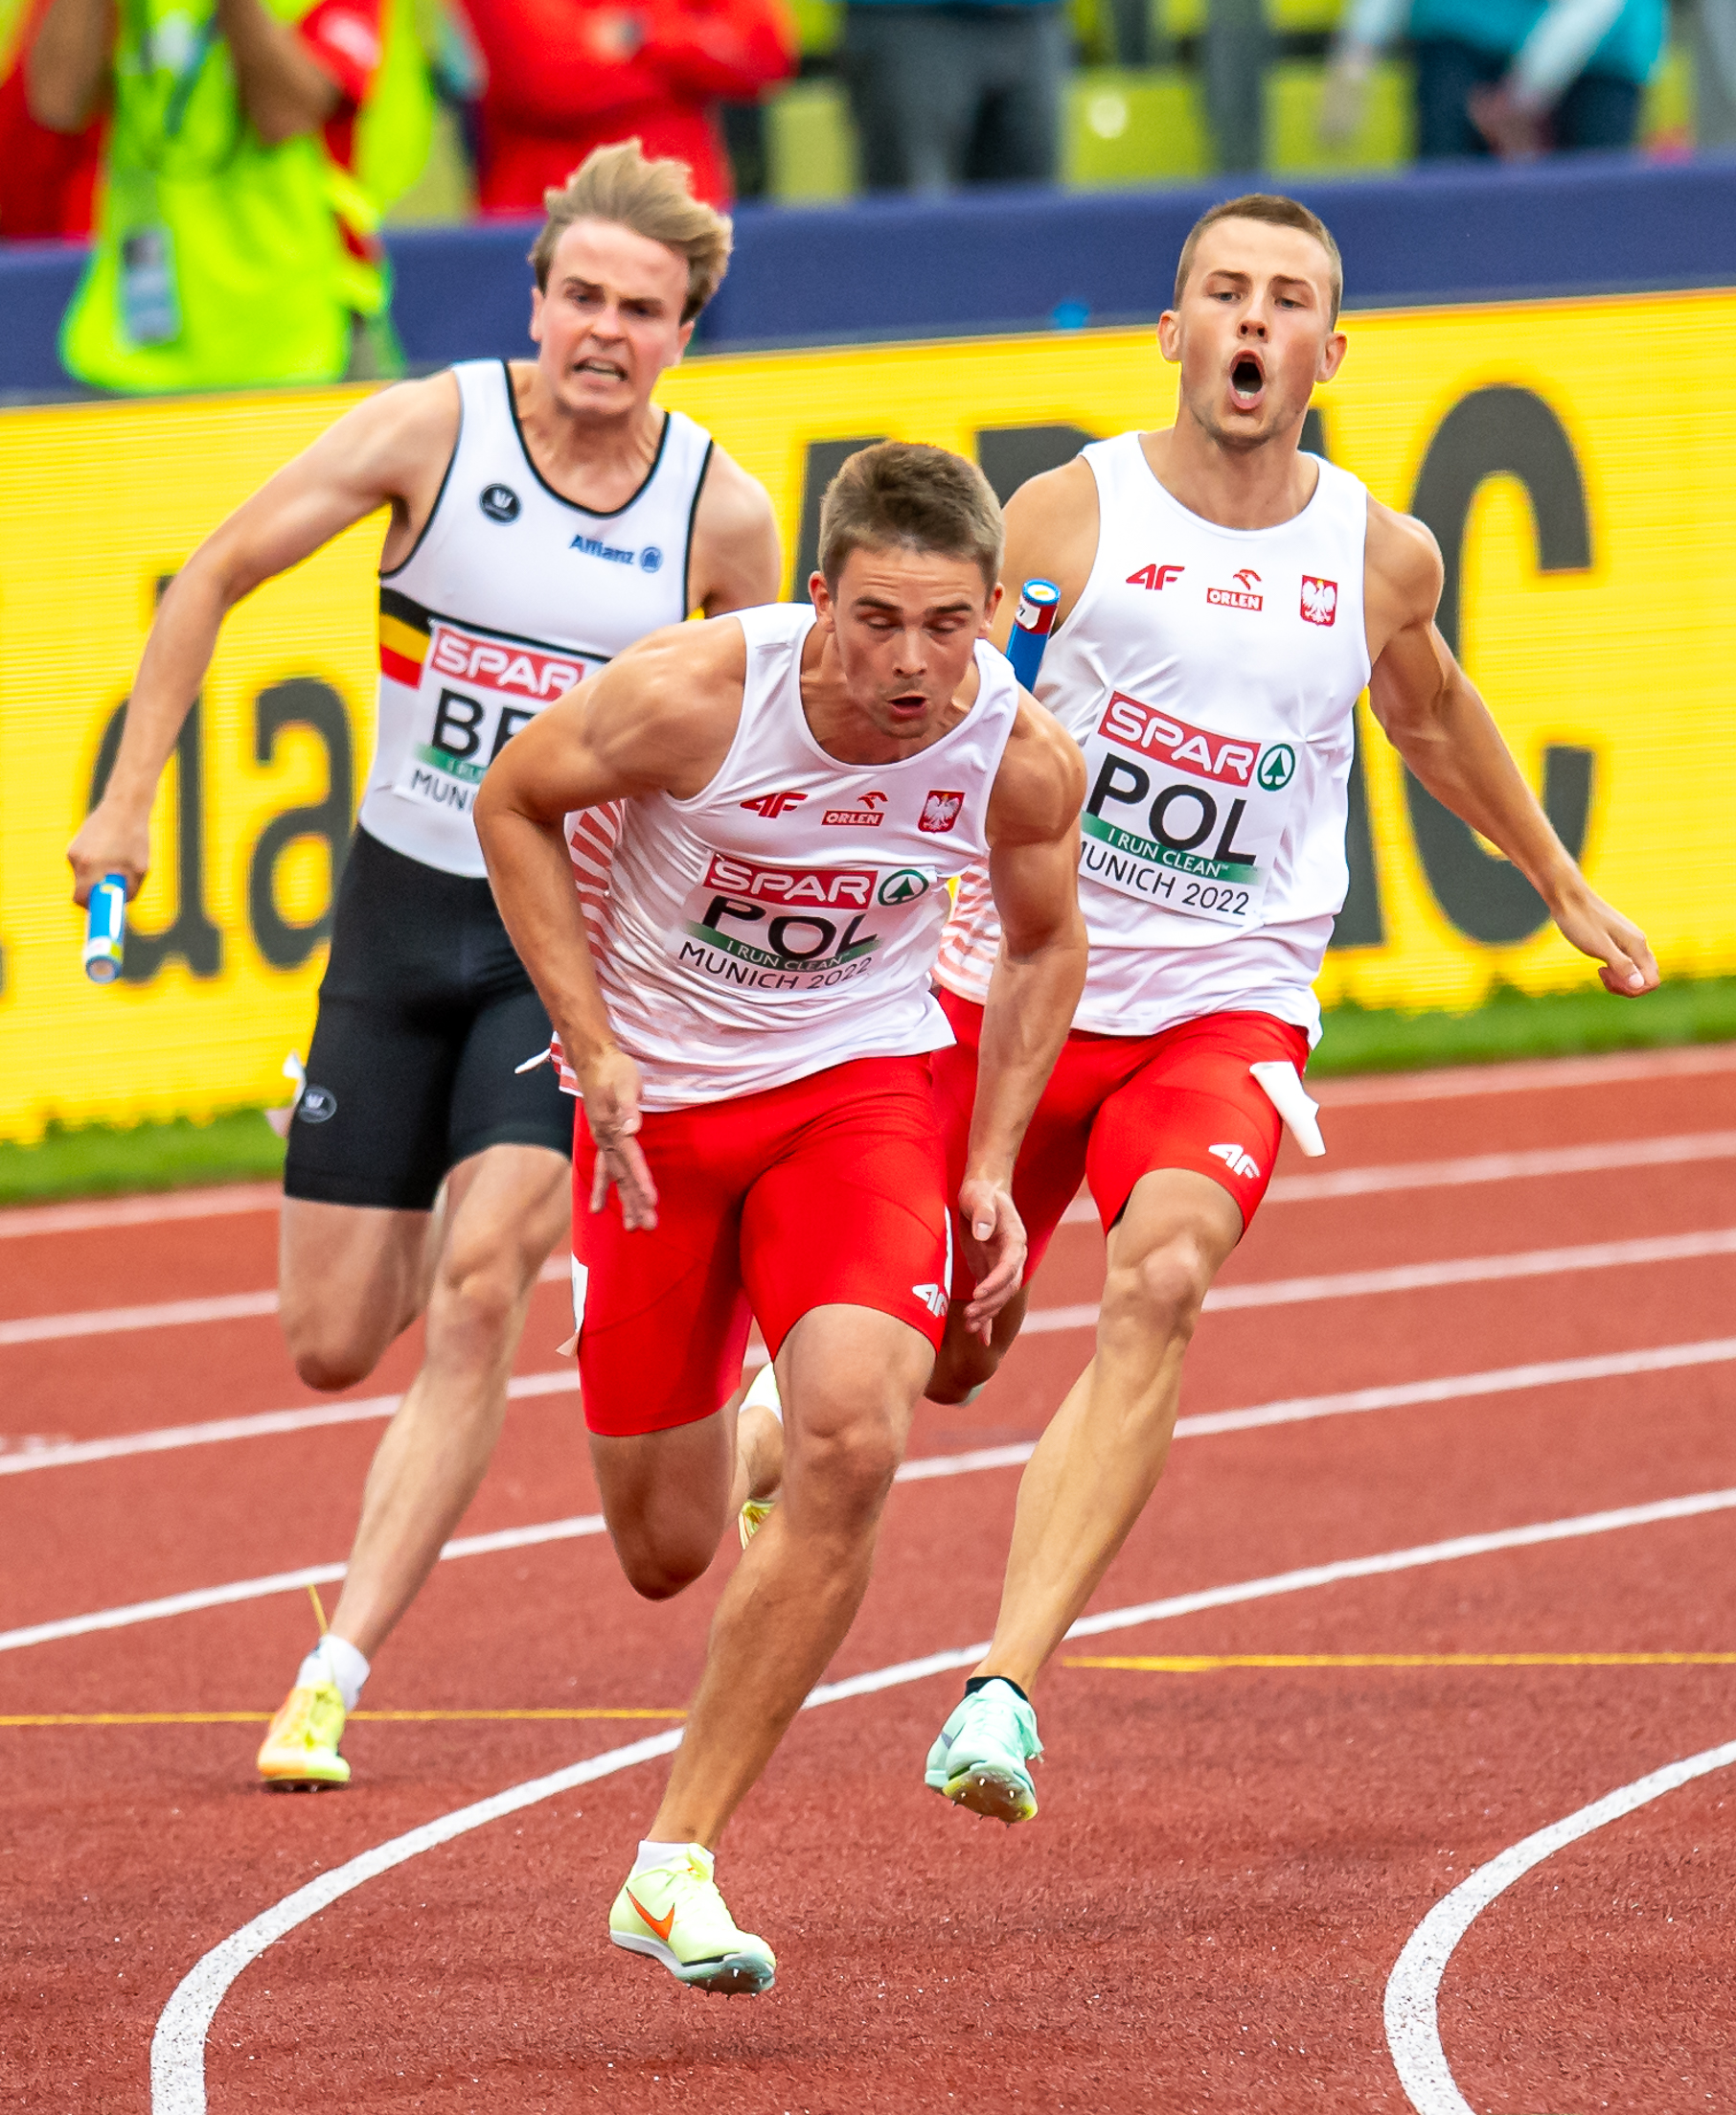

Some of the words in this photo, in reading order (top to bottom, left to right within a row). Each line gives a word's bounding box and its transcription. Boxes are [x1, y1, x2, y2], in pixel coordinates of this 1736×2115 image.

[569, 535, 635, 565] Allianz
[1126, 563, 1185, 590] 4F
[1210, 590, 1260, 610] ORLEN
[1106, 701, 1254, 781] SPAR
[740, 792, 809, 818] 4F
[826, 812, 880, 825] ORLEN
[1085, 752, 1257, 866] POL
[1108, 827, 1116, 842] I
[1118, 835, 1159, 860] RUN
[710, 862, 871, 905] SPAR
[1081, 840, 1176, 899] UNICH
[1181, 883, 1249, 915] 2022
[701, 894, 879, 959] POL
[679, 941, 799, 989] MUNICH
[808, 956, 872, 989] 2022
[726, 940, 733, 952] I
[737, 946, 780, 968] RUN
[1208, 1143, 1261, 1179] 4F
